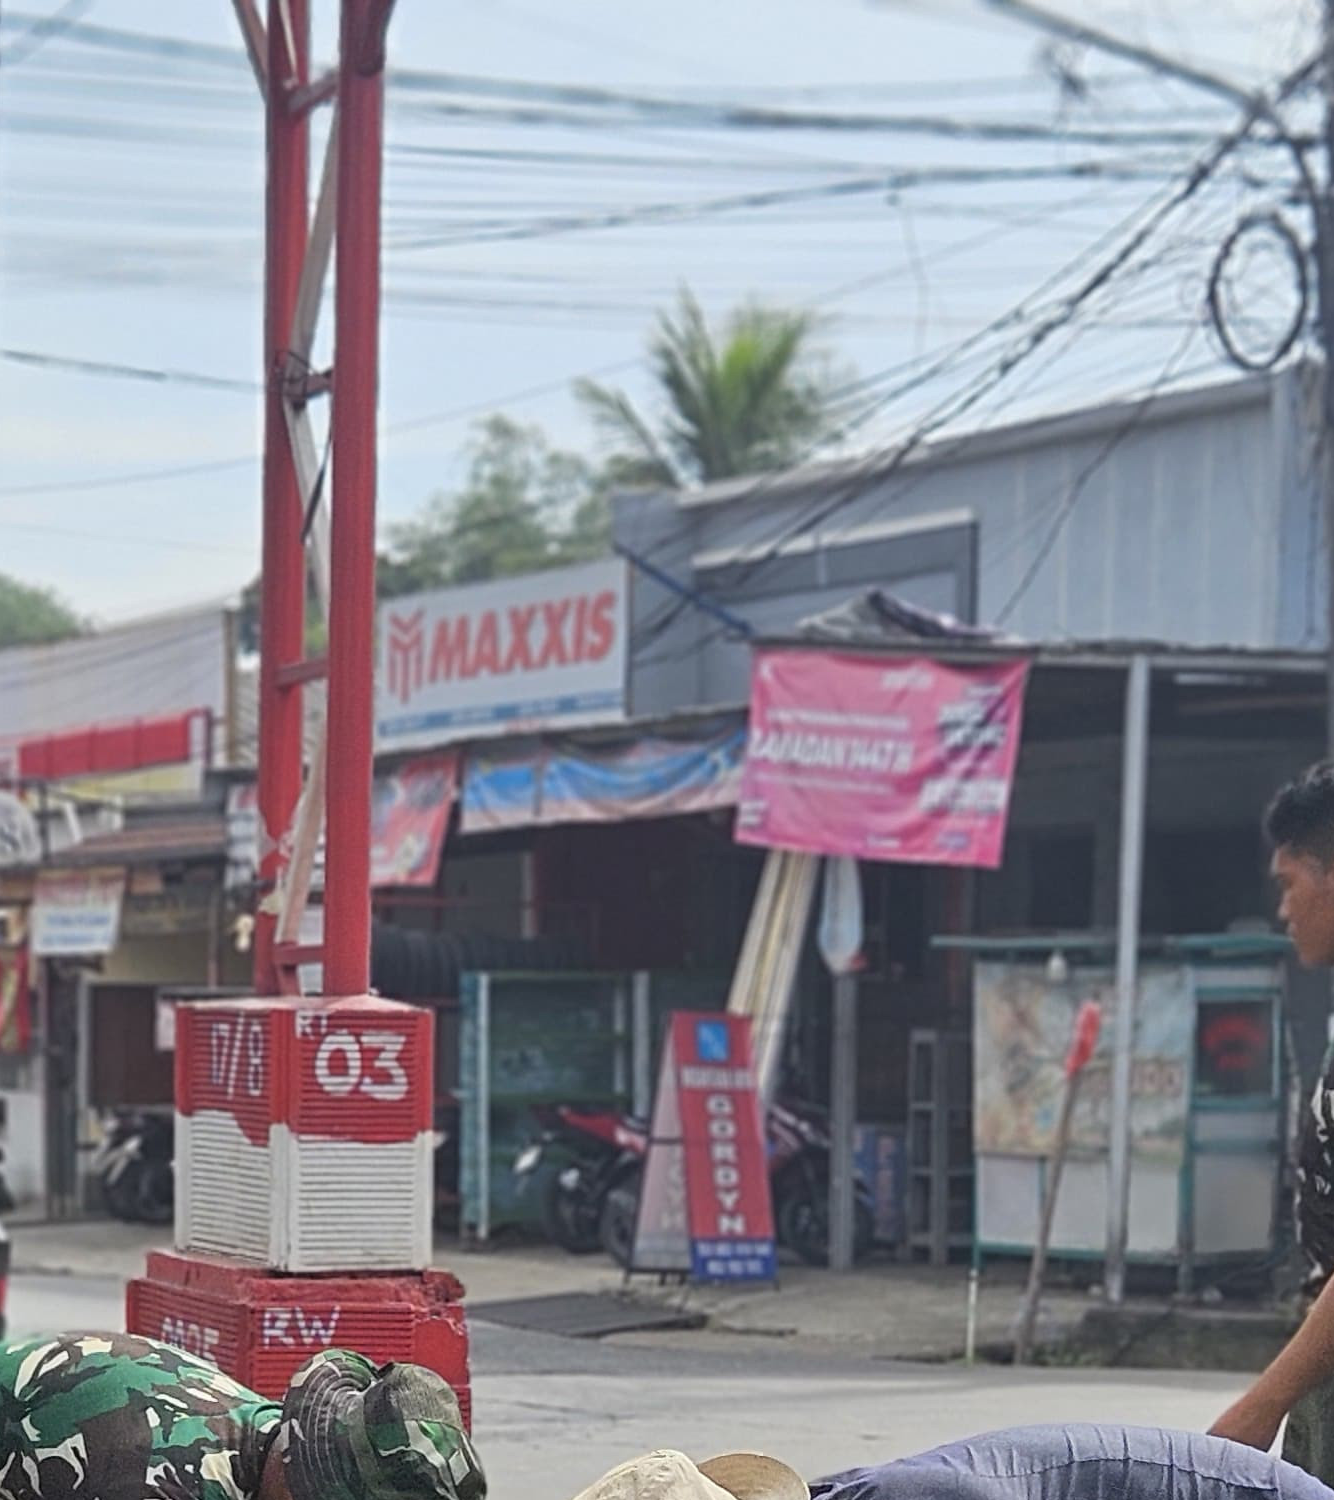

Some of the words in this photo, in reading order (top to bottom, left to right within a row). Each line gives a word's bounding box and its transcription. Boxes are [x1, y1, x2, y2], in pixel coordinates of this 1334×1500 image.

[428, 589, 618, 684] MAXXIS
[314, 1030, 409, 1100] 03
[705, 1094, 747, 1235] GORDYN
[263, 1305, 341, 1348] RW
